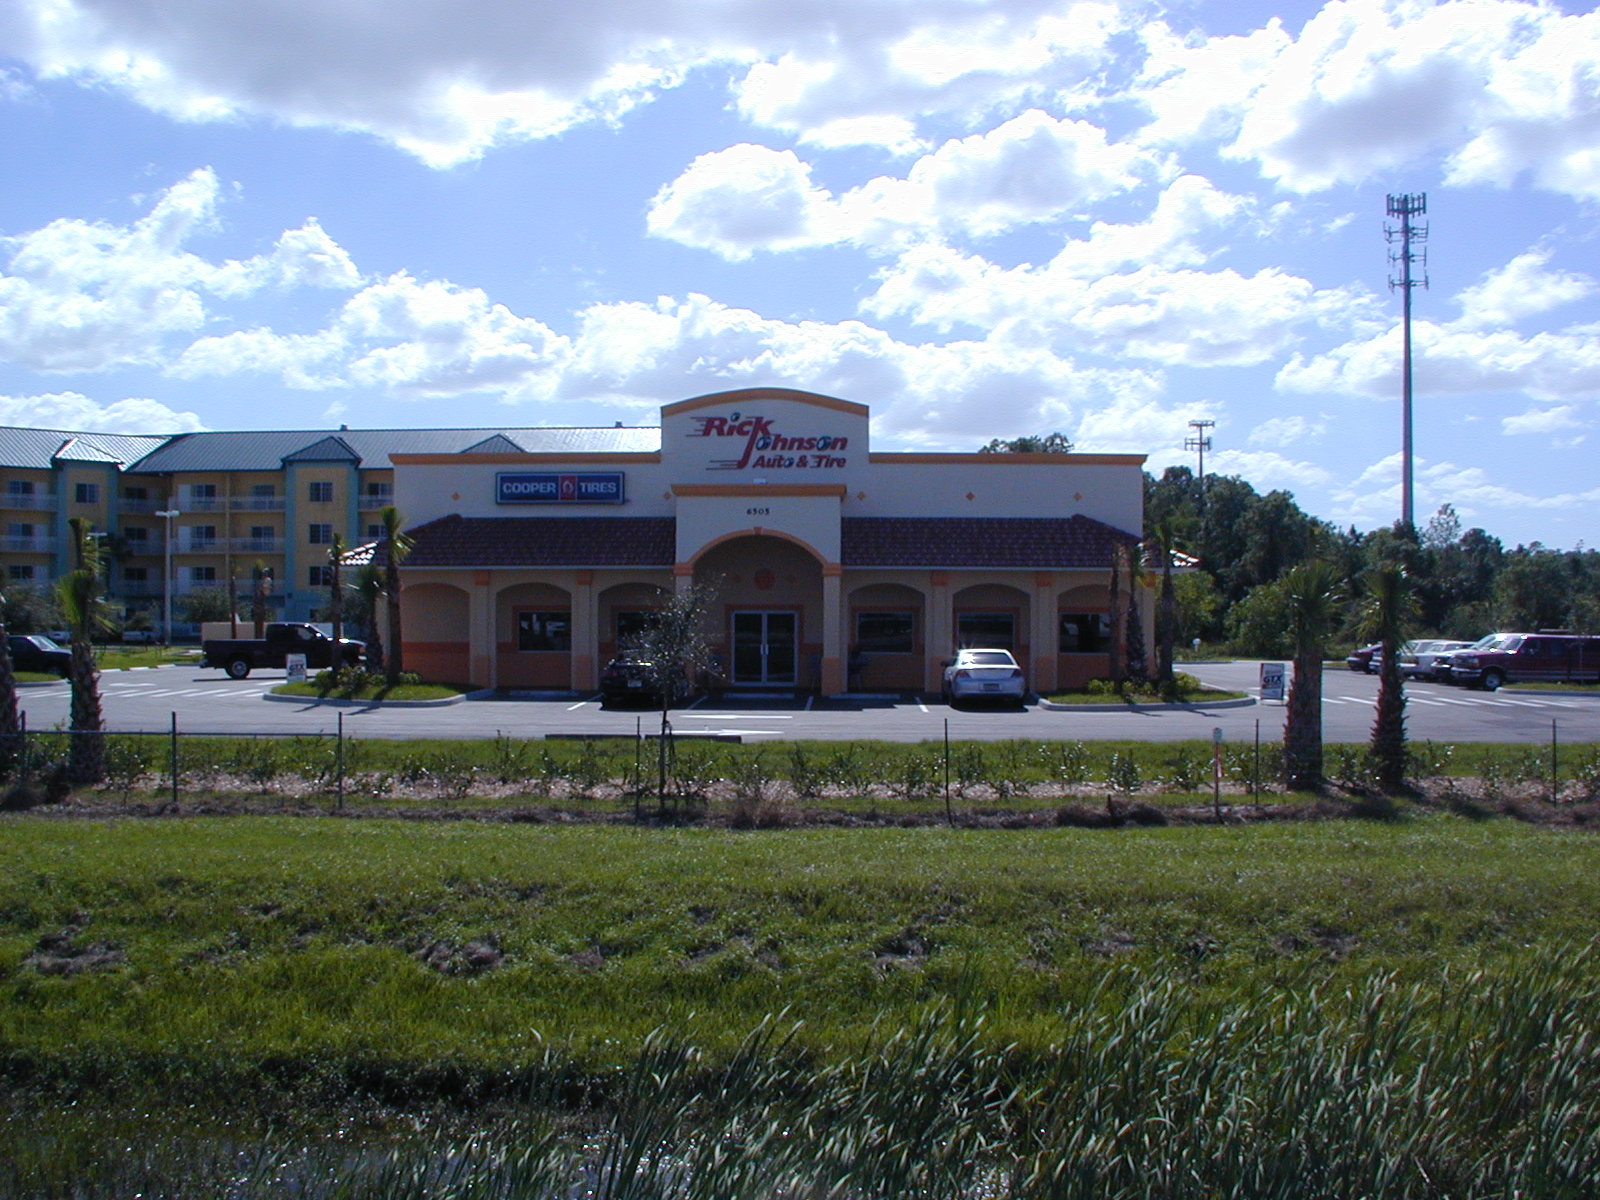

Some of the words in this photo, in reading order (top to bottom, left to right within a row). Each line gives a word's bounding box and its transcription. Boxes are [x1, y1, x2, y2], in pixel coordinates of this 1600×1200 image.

[752, 455, 794, 468] Auto
[796, 455, 807, 468] &
[811, 455, 846, 468] Tire
[503, 482, 556, 493] COOPER
[580, 482, 616, 493] TIRES
